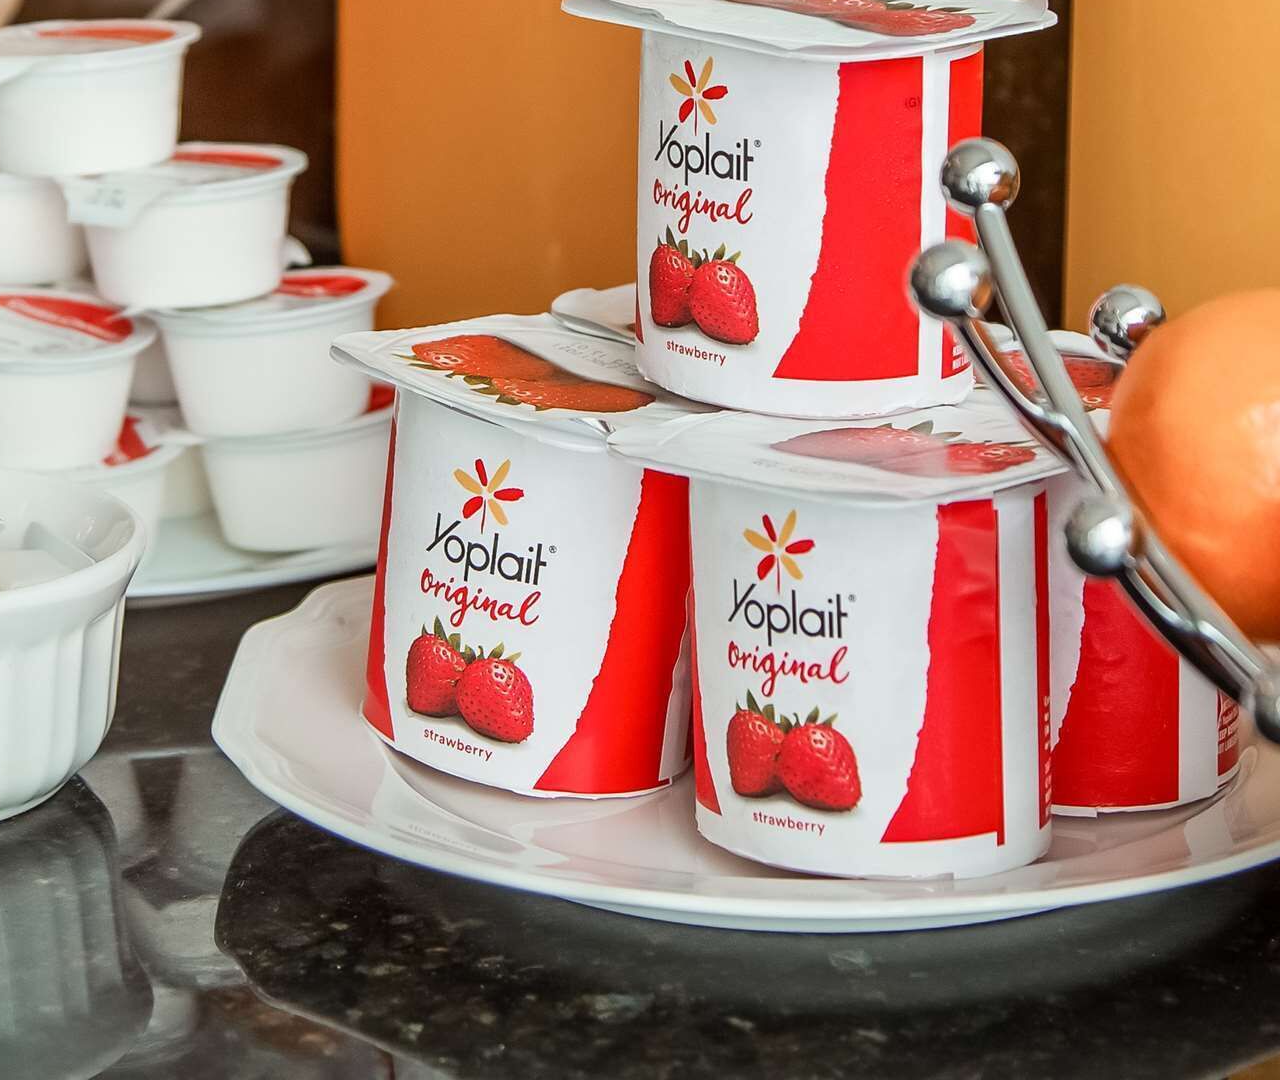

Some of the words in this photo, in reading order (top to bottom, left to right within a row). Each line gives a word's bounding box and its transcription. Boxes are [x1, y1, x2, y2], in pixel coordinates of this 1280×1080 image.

[653, 178, 753, 233] Original
[666, 340, 726, 366] strawberry
[421, 567, 541, 627] Original
[728, 640, 849, 697] Original
[423, 728, 493, 762] strawberry
[753, 811, 825, 837] strawberry
